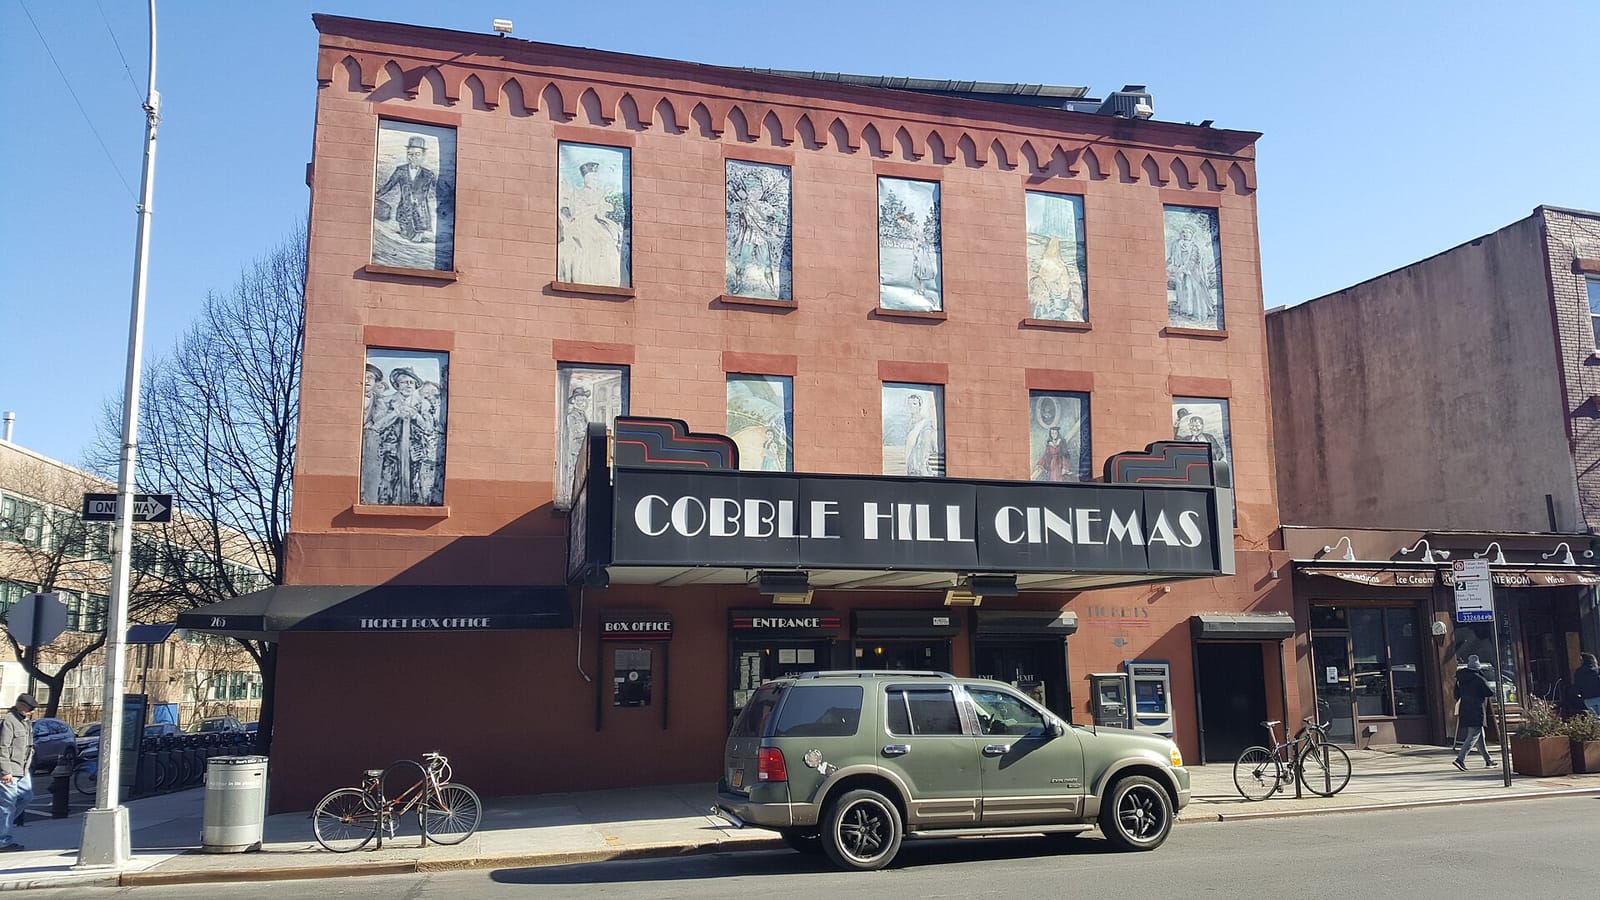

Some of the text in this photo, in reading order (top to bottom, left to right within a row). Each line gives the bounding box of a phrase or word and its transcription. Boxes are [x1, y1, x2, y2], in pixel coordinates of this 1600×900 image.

[133, 503, 158, 514] WAY
[635, 494, 841, 539] COBBLE
[863, 502, 975, 542] HILL
[994, 506, 1203, 548] CINEMAS
[1396, 575, 1408, 584] Ice
[1408, 575, 1435, 584] Cream
[1506, 575, 1531, 585] ROOM
[1544, 575, 1565, 584] Wine
[1457, 581, 1465, 590] 2
[211, 616, 226, 627] 265
[360, 617, 491, 628] TICKET BOX OFFICE
[605, 621, 672, 632] BOX OFFICE
[752, 617, 820, 628] ENTRANCE
